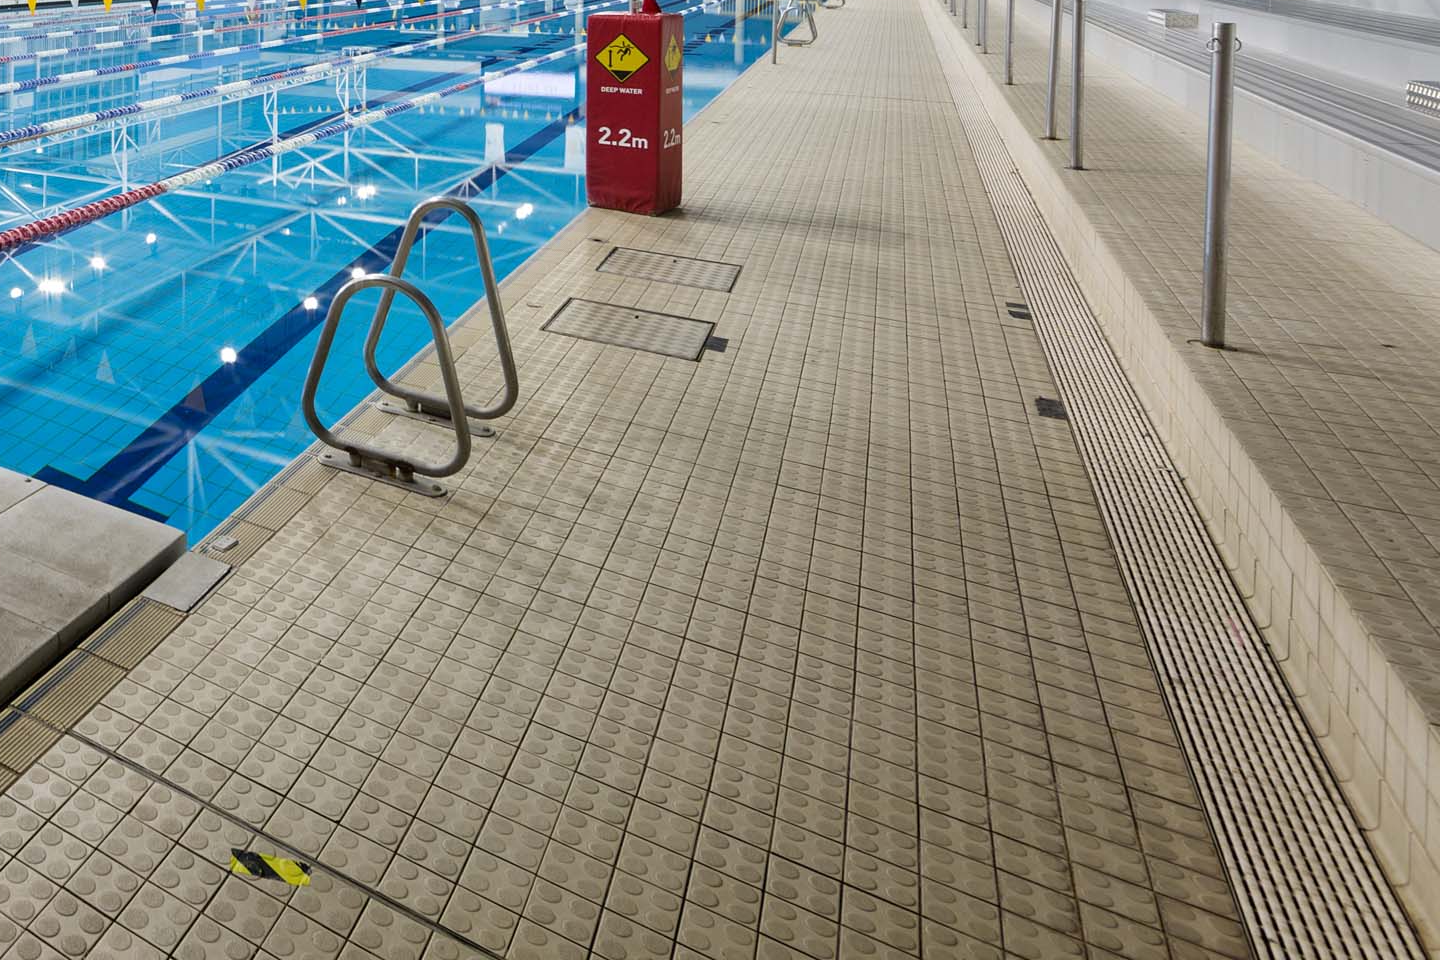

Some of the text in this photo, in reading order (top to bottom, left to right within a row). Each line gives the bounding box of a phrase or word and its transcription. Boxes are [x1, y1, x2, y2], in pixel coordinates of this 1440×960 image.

[619, 87, 643, 95] WATER
[598, 126, 649, 150] 2.2m
[663, 128, 681, 149] 2.2m
